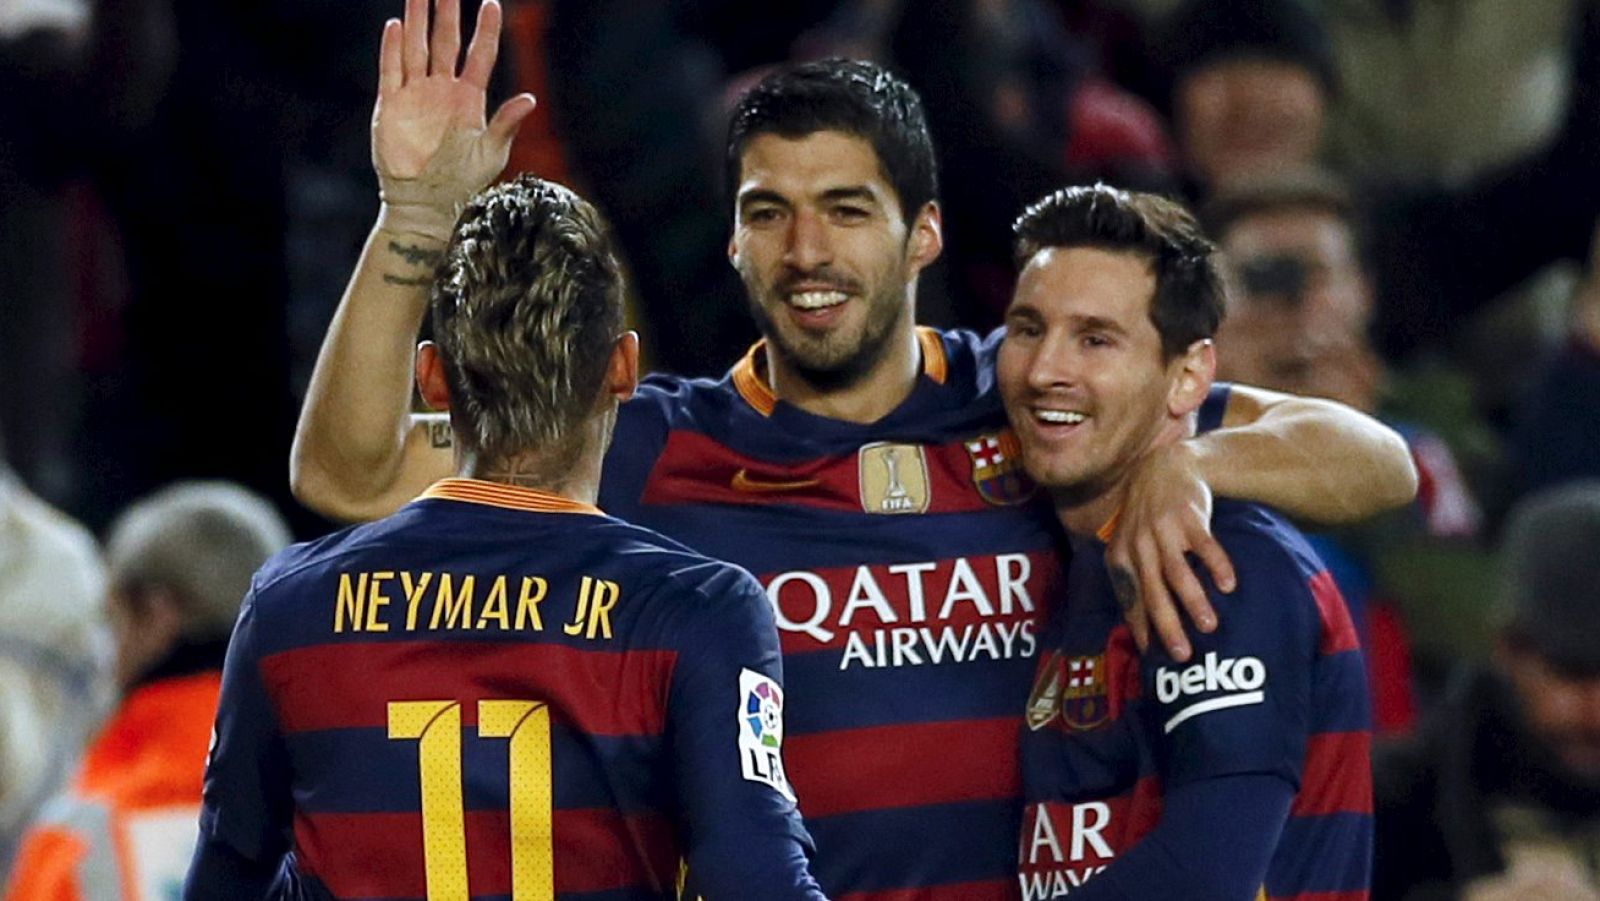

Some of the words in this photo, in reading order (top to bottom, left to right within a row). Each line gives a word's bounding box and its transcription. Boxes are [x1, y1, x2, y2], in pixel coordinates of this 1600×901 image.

[881, 496, 912, 510] FIFA
[333, 570, 548, 633] NEYMAR
[563, 575, 620, 640] JR
[766, 553, 1035, 643] QATAR
[839, 619, 1036, 671] AIRWAYS
[1155, 651, 1266, 704] beko
[386, 699, 555, 901] 11
[1019, 801, 1115, 864] AR
[1018, 865, 1107, 901] WAY
